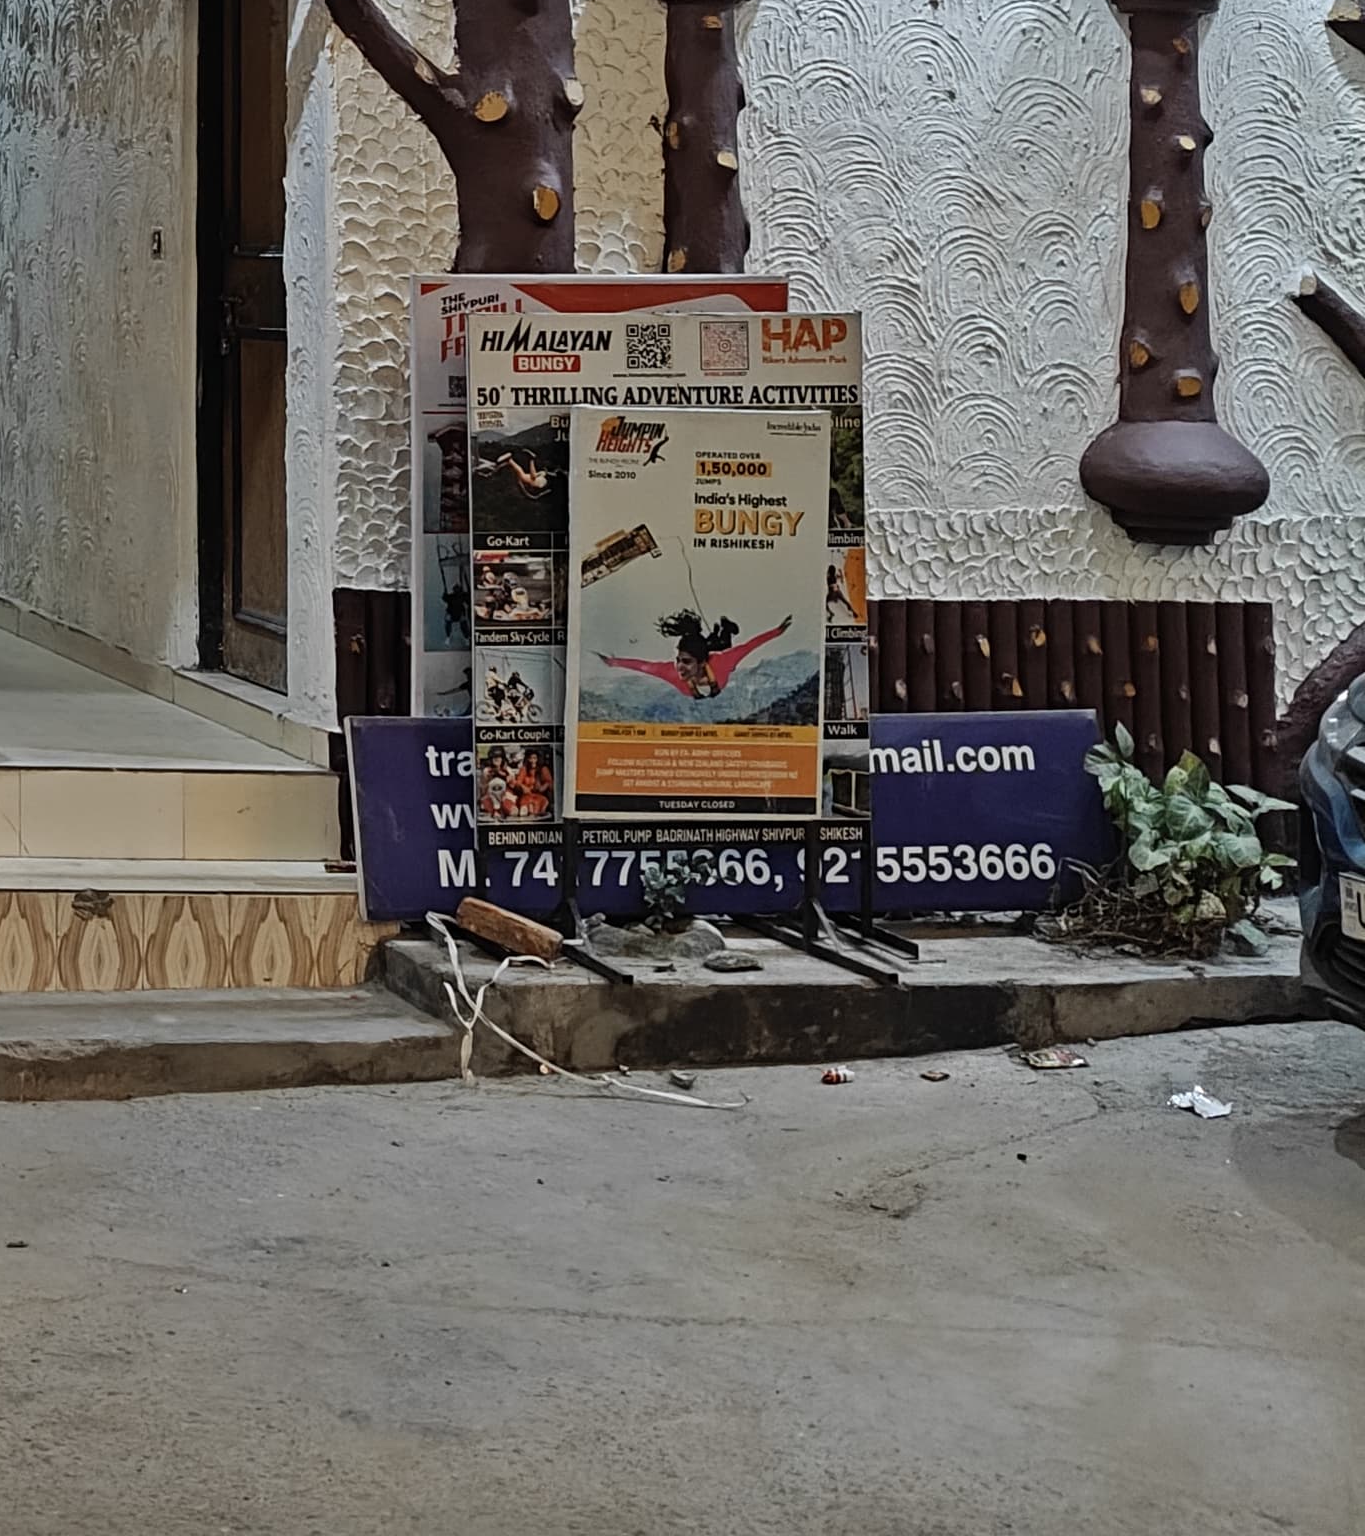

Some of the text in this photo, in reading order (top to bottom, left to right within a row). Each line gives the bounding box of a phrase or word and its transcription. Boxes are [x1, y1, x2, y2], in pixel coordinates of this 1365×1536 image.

[440, 292, 466, 306] THE
[480, 318, 613, 353] HIMALAYAN
[761, 317, 848, 353] HAP
[518, 356, 575, 371] BUNGY
[511, 386, 618, 406] THRILLING
[623, 385, 744, 405] ADVENTURE
[749, 384, 859, 405] ACTIVITIES
[695, 451, 761, 460] OPERATED OVER
[614, 471, 637, 479] 2010
[699, 462, 768, 477] 1,50,000
[694, 492, 788, 508] India's Highest
[694, 508, 805, 537] BUNGY
[486, 535, 530, 546] Go-Kart
[693, 538, 775, 550] IN RISHIKESH
[475, 631, 550, 645] Tandem Sky-Cycle
[479, 729, 515, 741] Go-Kart
[517, 729, 551, 744] Couple
[827, 723, 858, 736] Walk
[659, 800, 736, 809] TUESDAY CLOSED
[488, 830, 526, 846] BEHIND
[527, 830, 563, 845] INDIAN
[582, 829, 622, 844] PETROL
[624, 828, 653, 843] PUMP
[656, 827, 714, 843] BADRINATH
[715, 827, 760, 842] HIGHWAY
